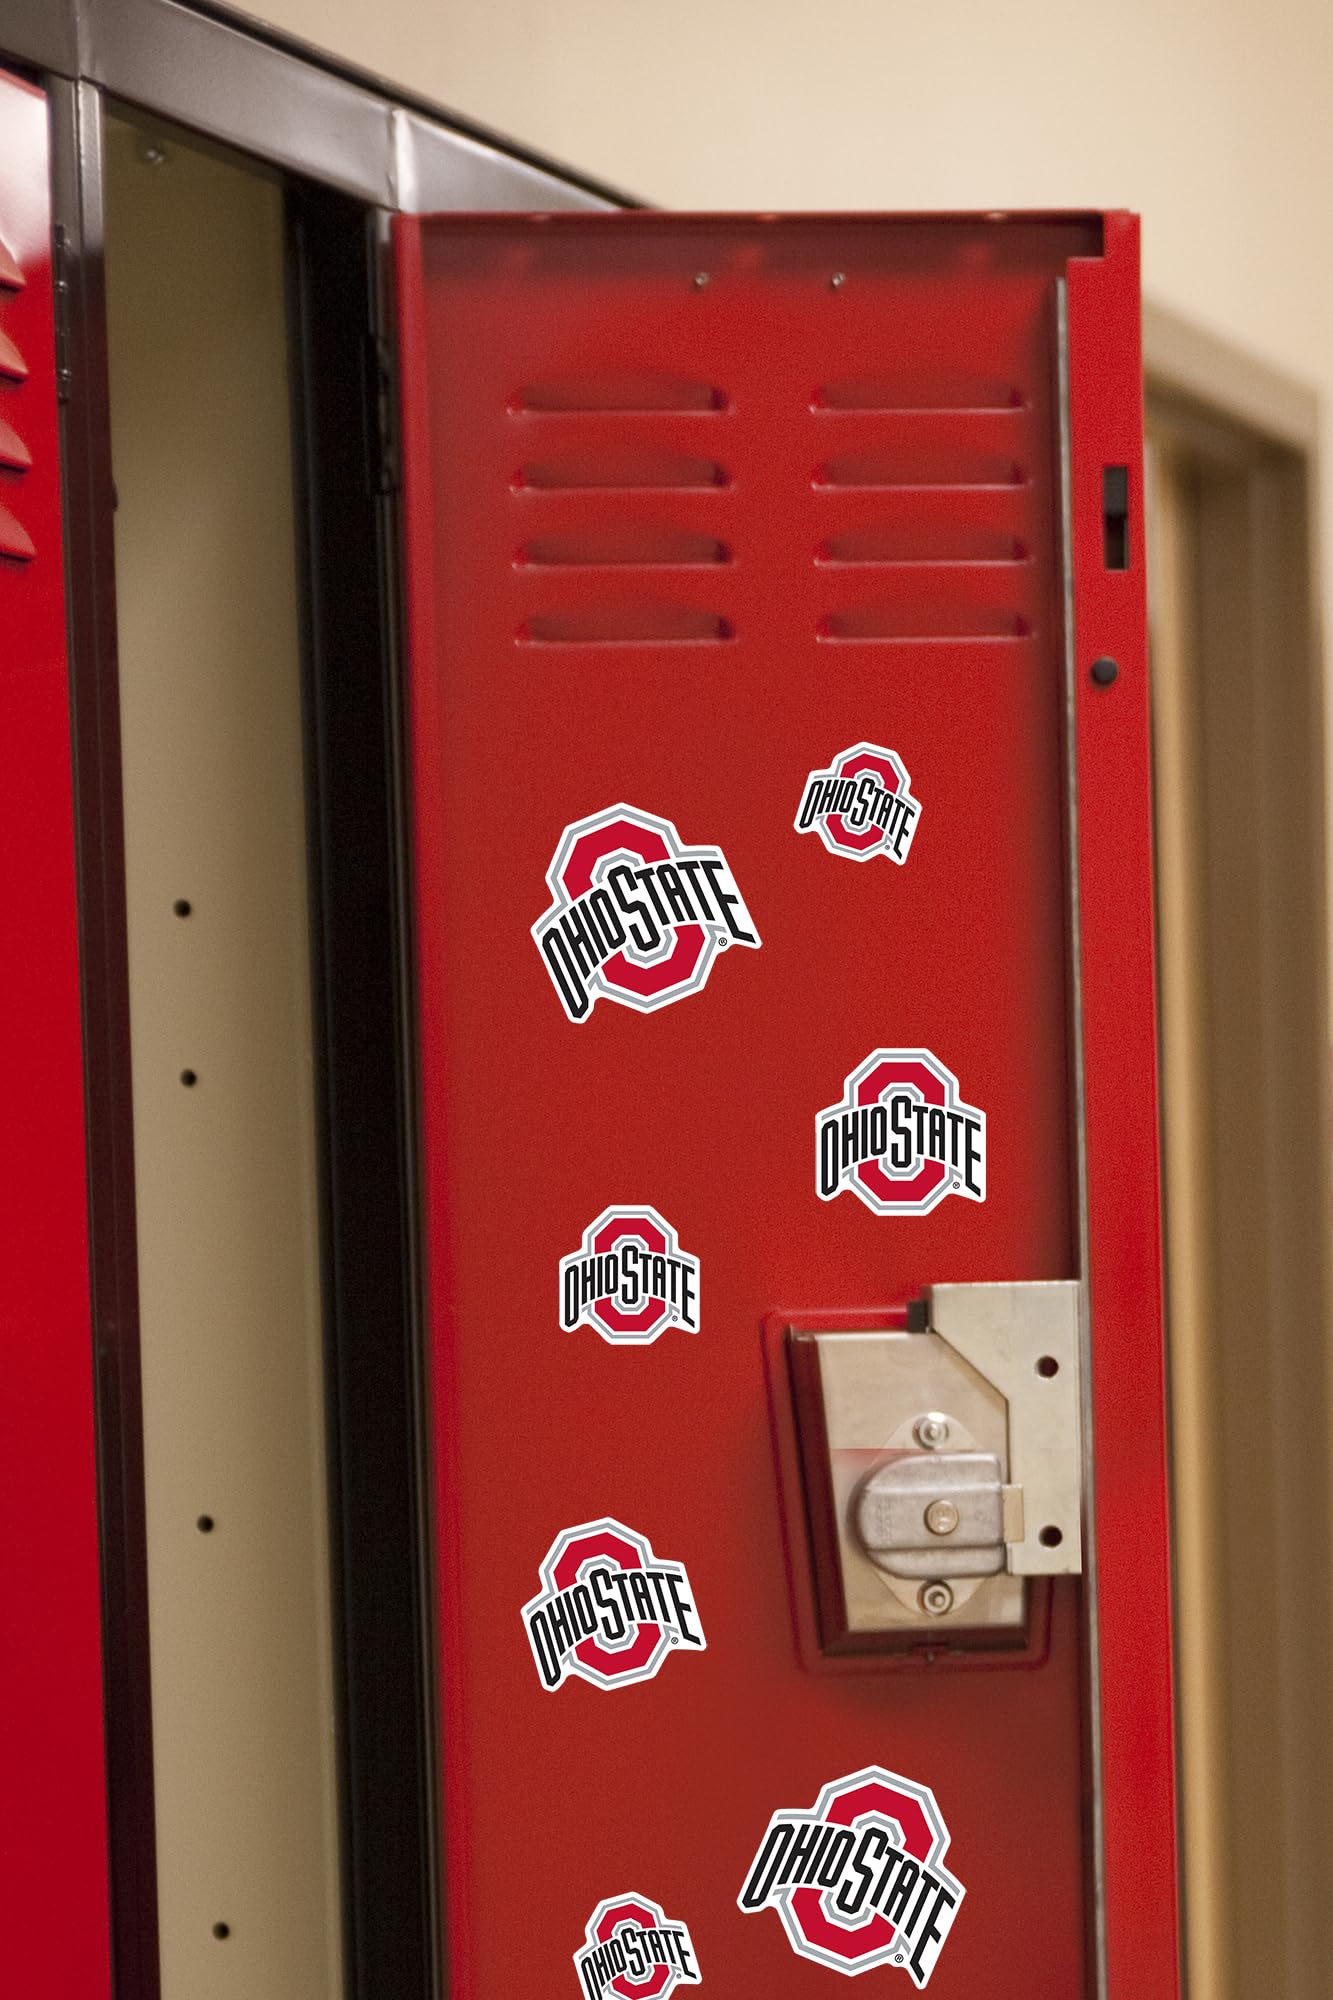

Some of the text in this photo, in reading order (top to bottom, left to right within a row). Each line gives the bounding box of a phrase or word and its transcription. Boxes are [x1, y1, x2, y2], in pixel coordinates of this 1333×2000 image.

[799, 778, 915, 860] OHIO STATE
[542, 861, 756, 1018] OHIO STATE
[821, 1096, 981, 1197] OHIO STATE
[565, 1245, 695, 1328] OHIO STATE
[530, 1568, 702, 1686] OHIO STATE
[742, 1824, 956, 1984] OHIO STATE
[581, 1927, 697, 2000] OHIO STATE
